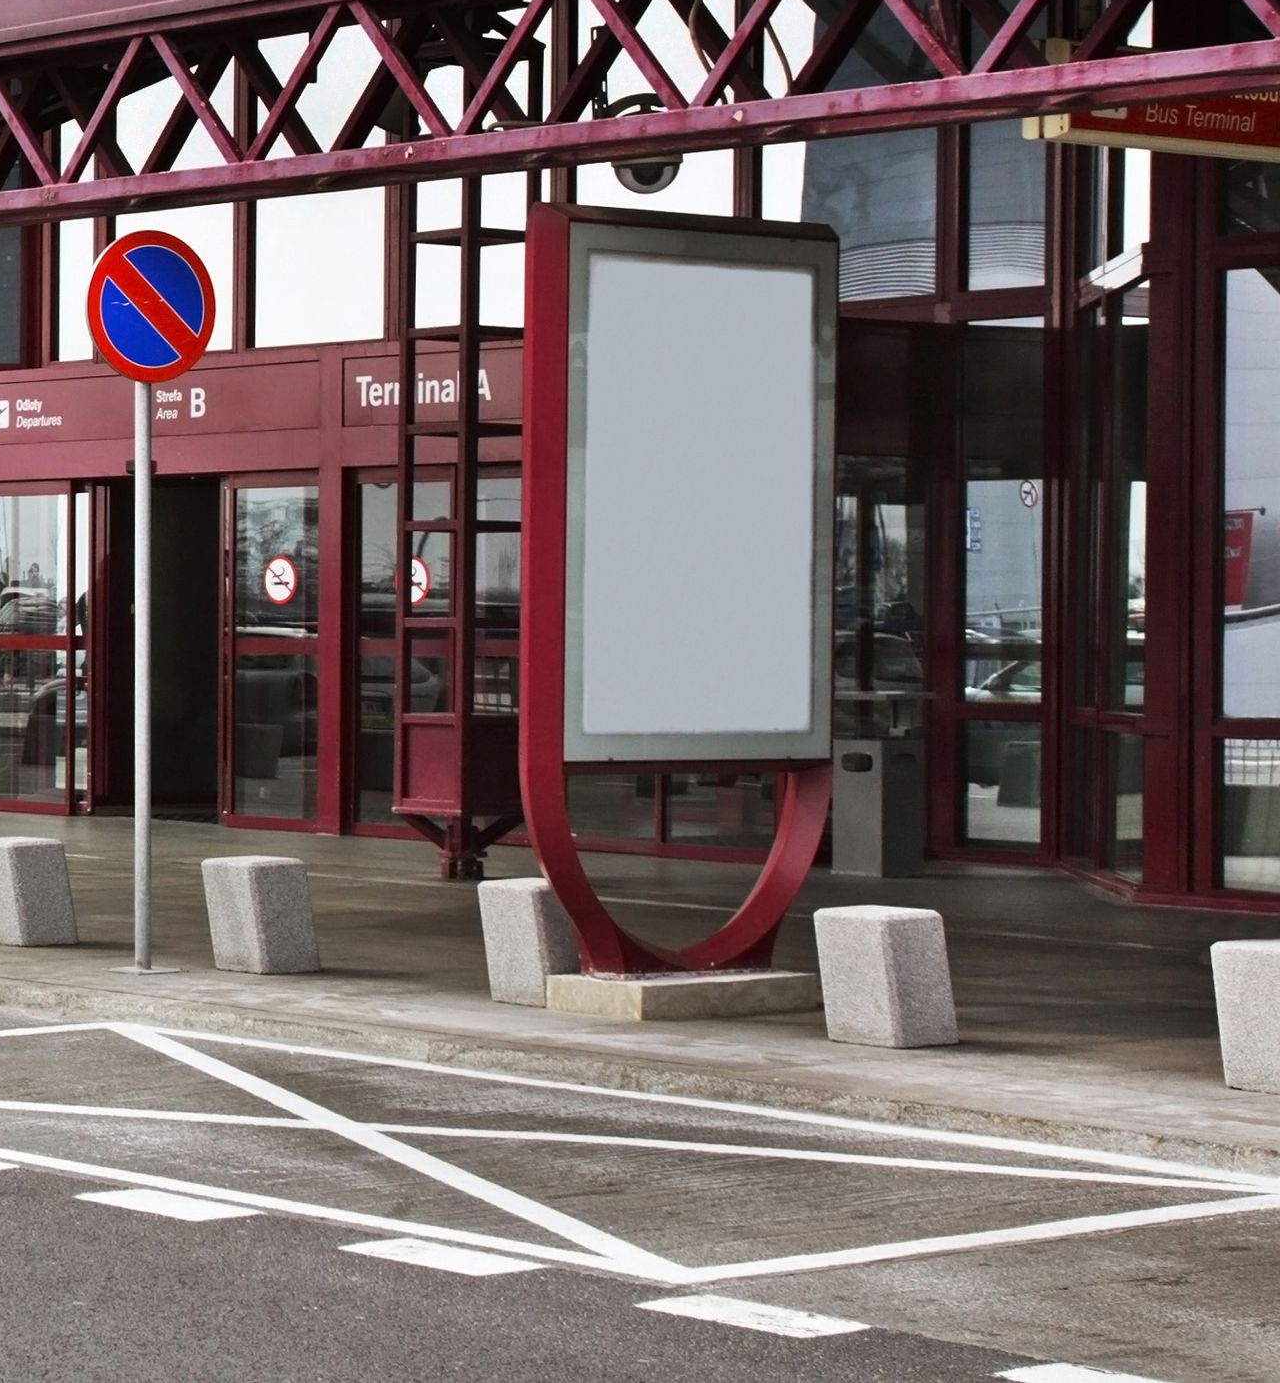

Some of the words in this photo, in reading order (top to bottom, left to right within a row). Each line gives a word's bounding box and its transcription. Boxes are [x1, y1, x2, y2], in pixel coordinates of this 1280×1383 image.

[1145, 102, 1179, 125] Bus
[1185, 104, 1256, 133] Terminal
[155, 389, 182, 403] Strefa
[356, 370, 459, 407] Terina
[478, 369, 491, 401] A
[15, 398, 43, 413] Odloty
[190, 387, 206, 418] B
[155, 407, 178, 420] Area
[15, 414, 63, 430] Departures
